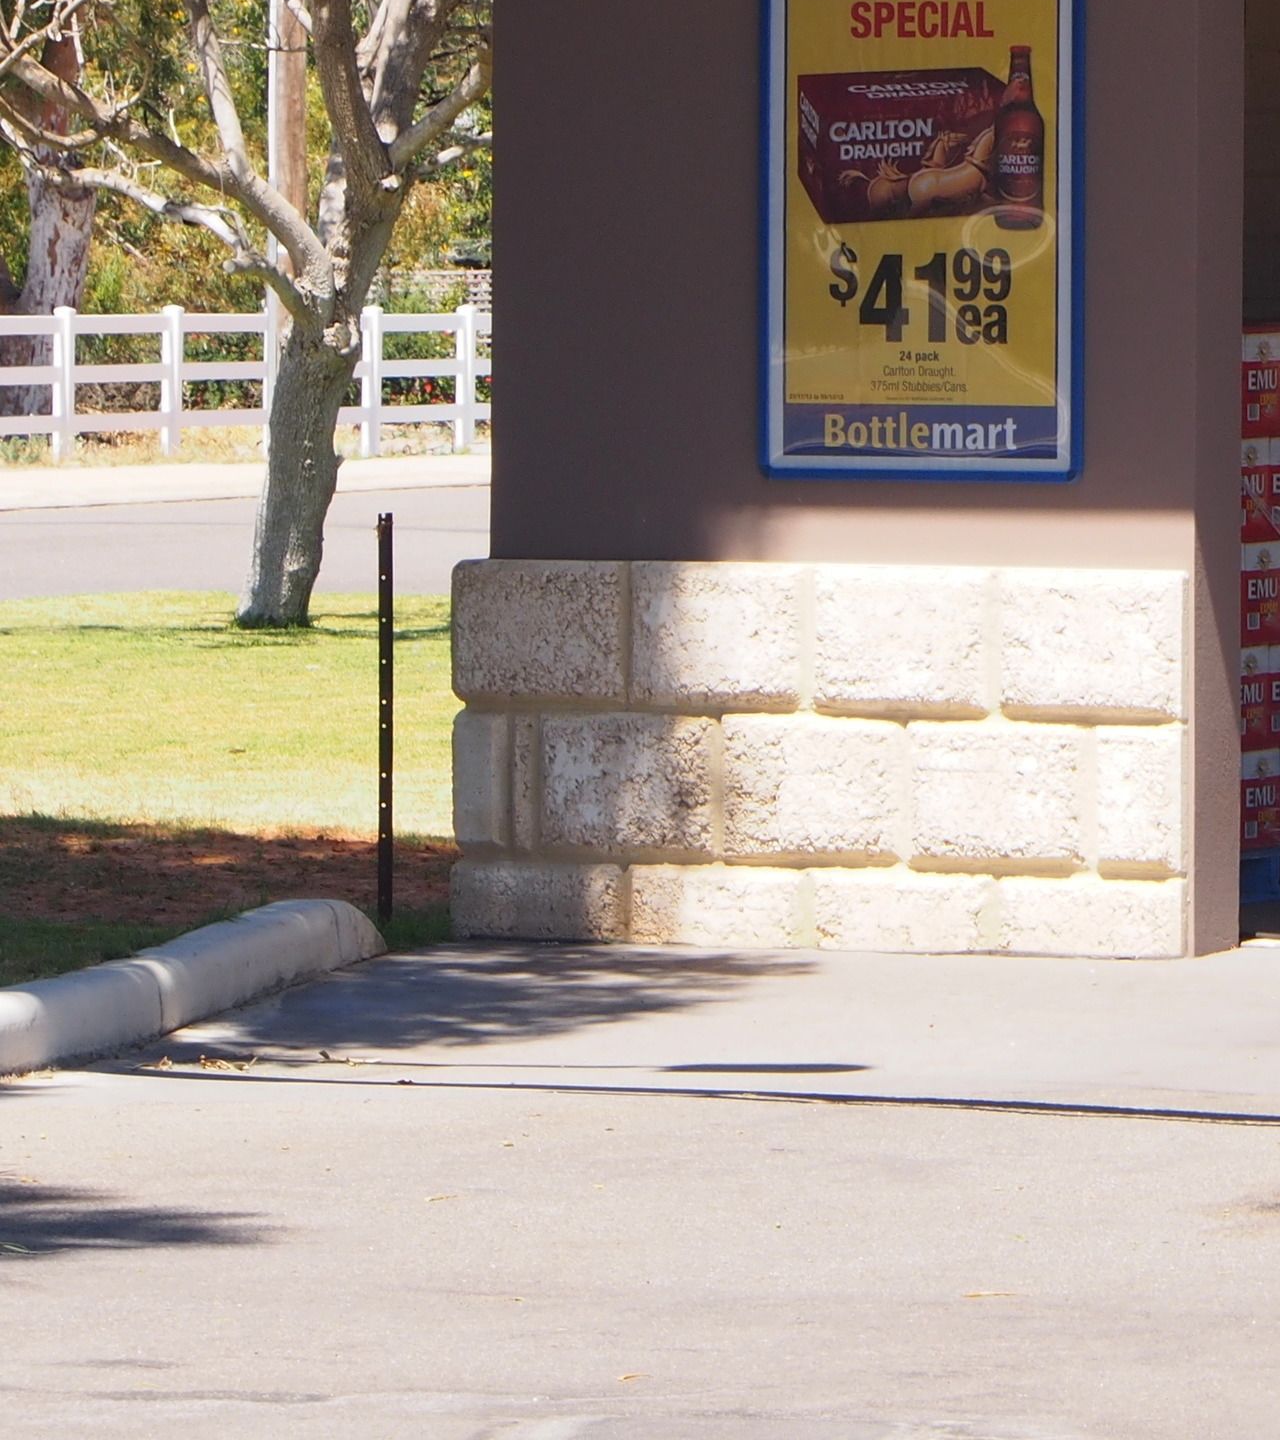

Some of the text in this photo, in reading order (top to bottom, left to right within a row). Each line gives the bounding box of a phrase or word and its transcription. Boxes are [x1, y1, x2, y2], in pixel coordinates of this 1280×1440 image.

[851, 0, 994, 38] SPECIAL
[847, 80, 969, 93] CARLTON
[866, 88, 964, 99] DRAUGHT
[829, 118, 933, 142] CARLTON
[840, 141, 924, 160] DRAUGHT
[953, 248, 1011, 302] 99
[955, 303, 1008, 345] ea
[899, 350, 939, 363] 24 pack
[883, 365, 915, 377] Carlton
[1248, 369, 1277, 391] EMU
[824, 412, 1017, 450] Bottlemart
[1248, 577, 1277, 600] EMU
[1246, 784, 1275, 808] EMU
